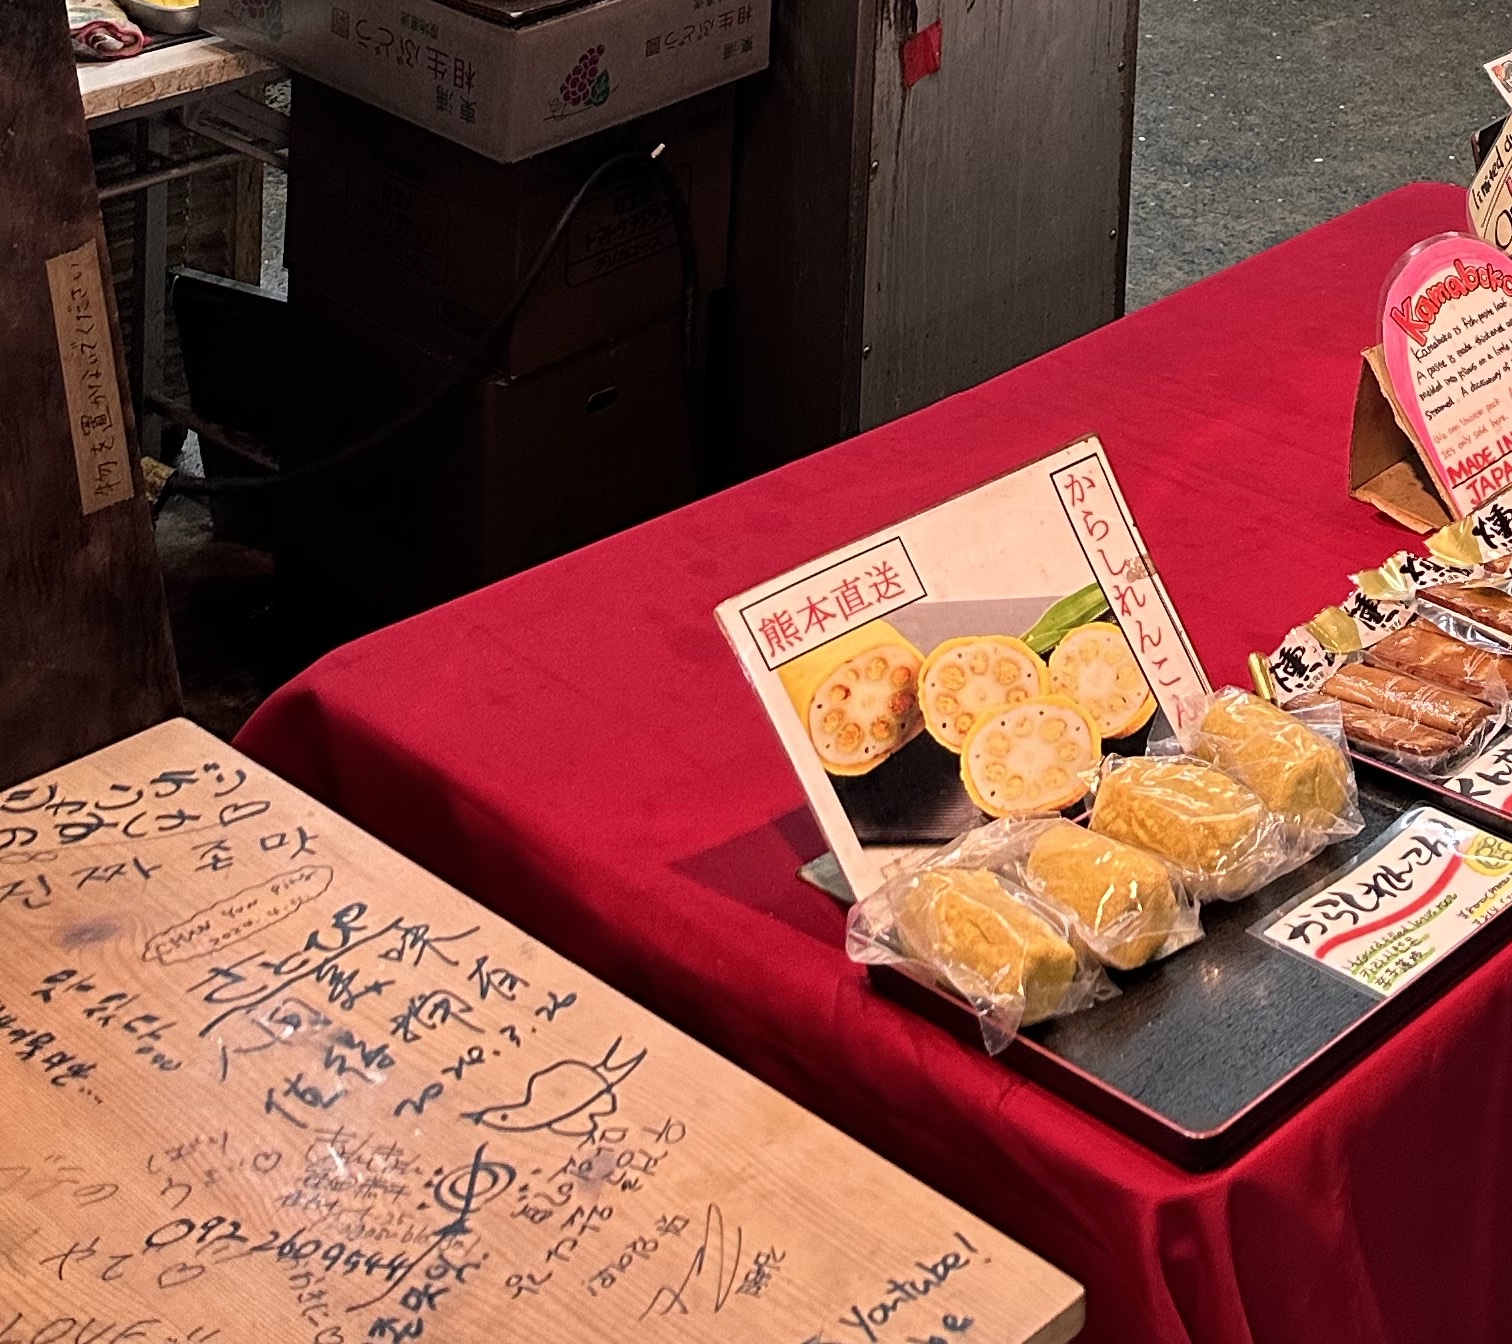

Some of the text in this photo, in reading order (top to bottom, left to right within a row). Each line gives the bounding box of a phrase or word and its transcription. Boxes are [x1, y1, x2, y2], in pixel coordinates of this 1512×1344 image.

[330, 7, 476, 94] 相生ぶどう園
[645, 5, 753, 58] 相生ぶどう園
[70, 261, 118, 498] 物を置かないでください
[1416, 370, 1427, 385] A
[1447, 444, 1493, 485] MADE
[753, 562, 906, 659] 熊本直送
[1062, 471, 1193, 731] からしれんこん
